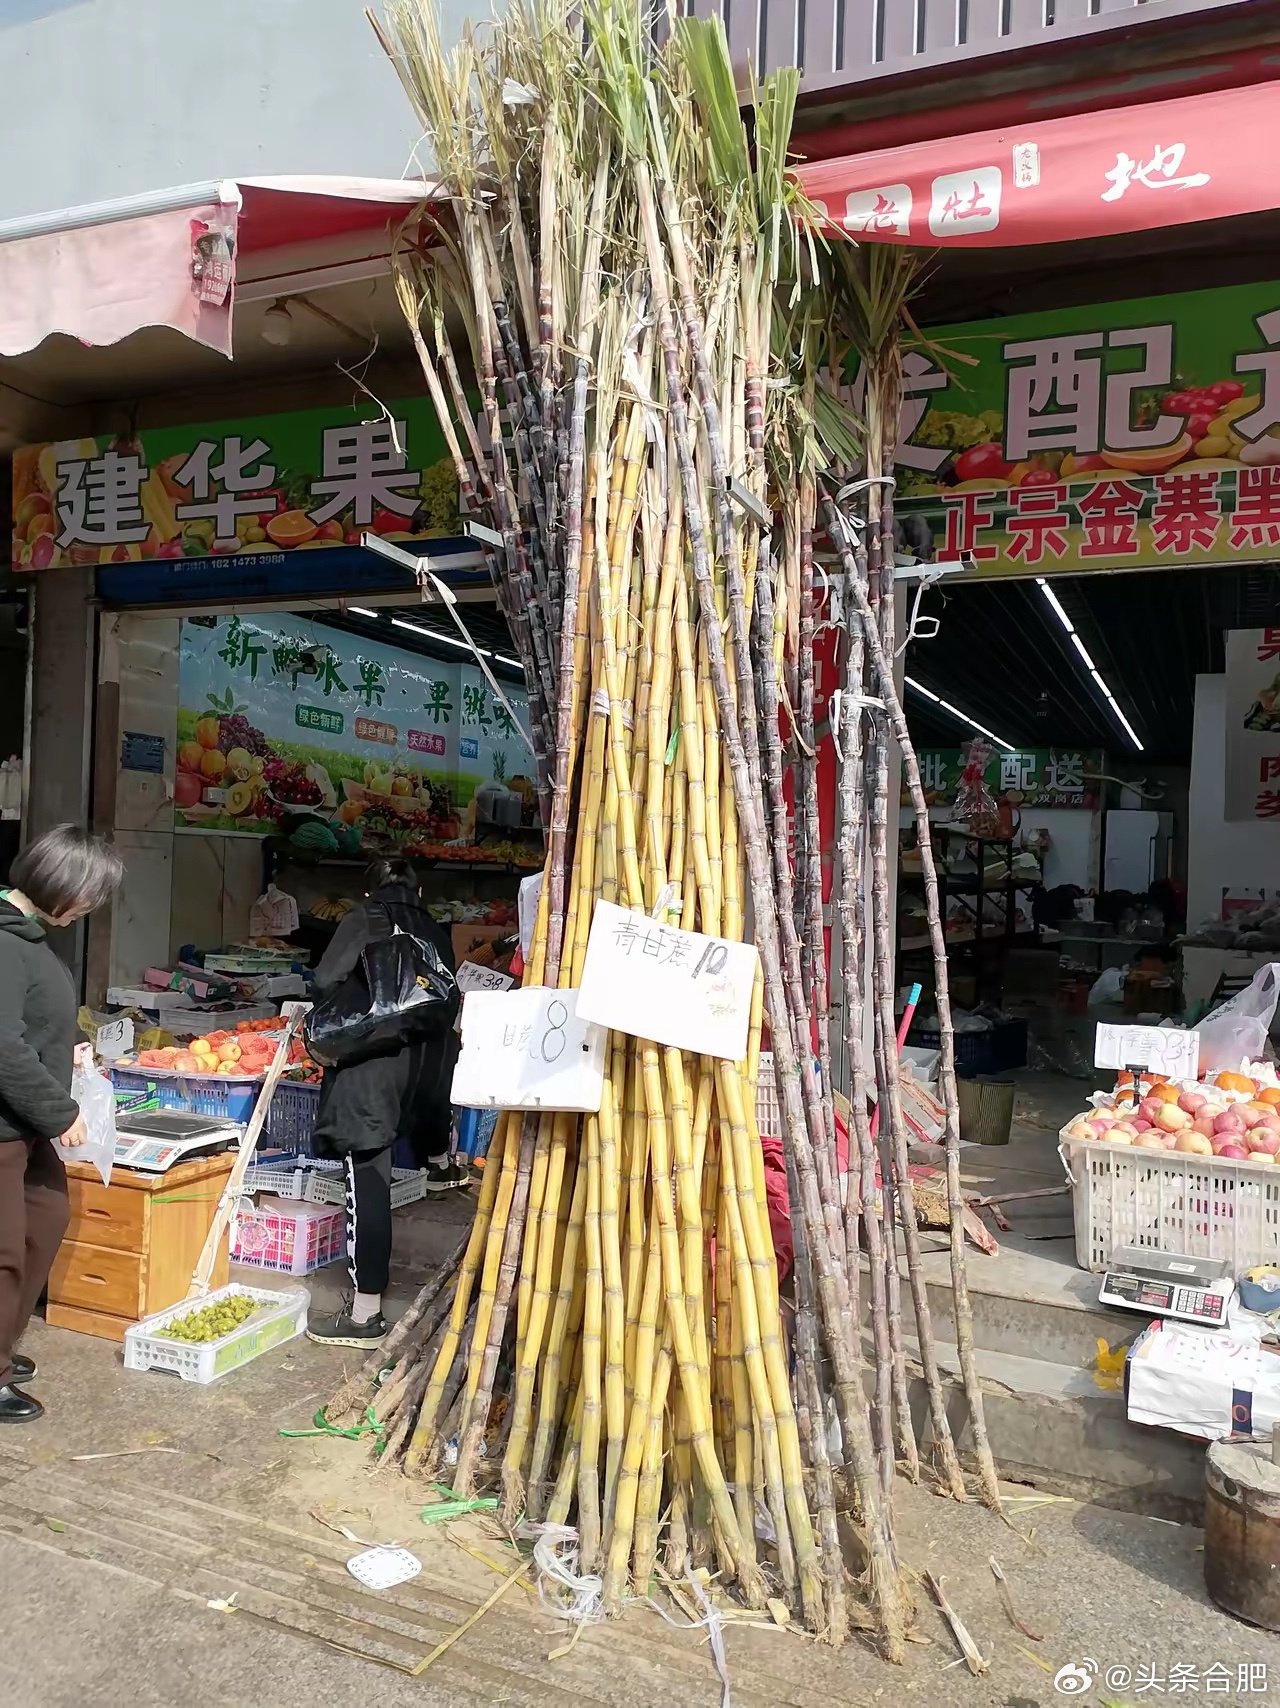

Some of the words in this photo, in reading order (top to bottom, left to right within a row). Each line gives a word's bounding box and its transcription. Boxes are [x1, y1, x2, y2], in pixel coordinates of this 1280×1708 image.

[1101, 143, 1211, 202] 地
[935, 466, 1280, 564] 正宗金寨黑
[409, 733, 443, 752] 天然水果
[917, 753, 1084, 792] 批配送
[691, 941, 729, 979] 10
[482, 973, 504, 991] 3.8
[115, 1020, 124, 1042] 3
[540, 999, 568, 1064] 8
